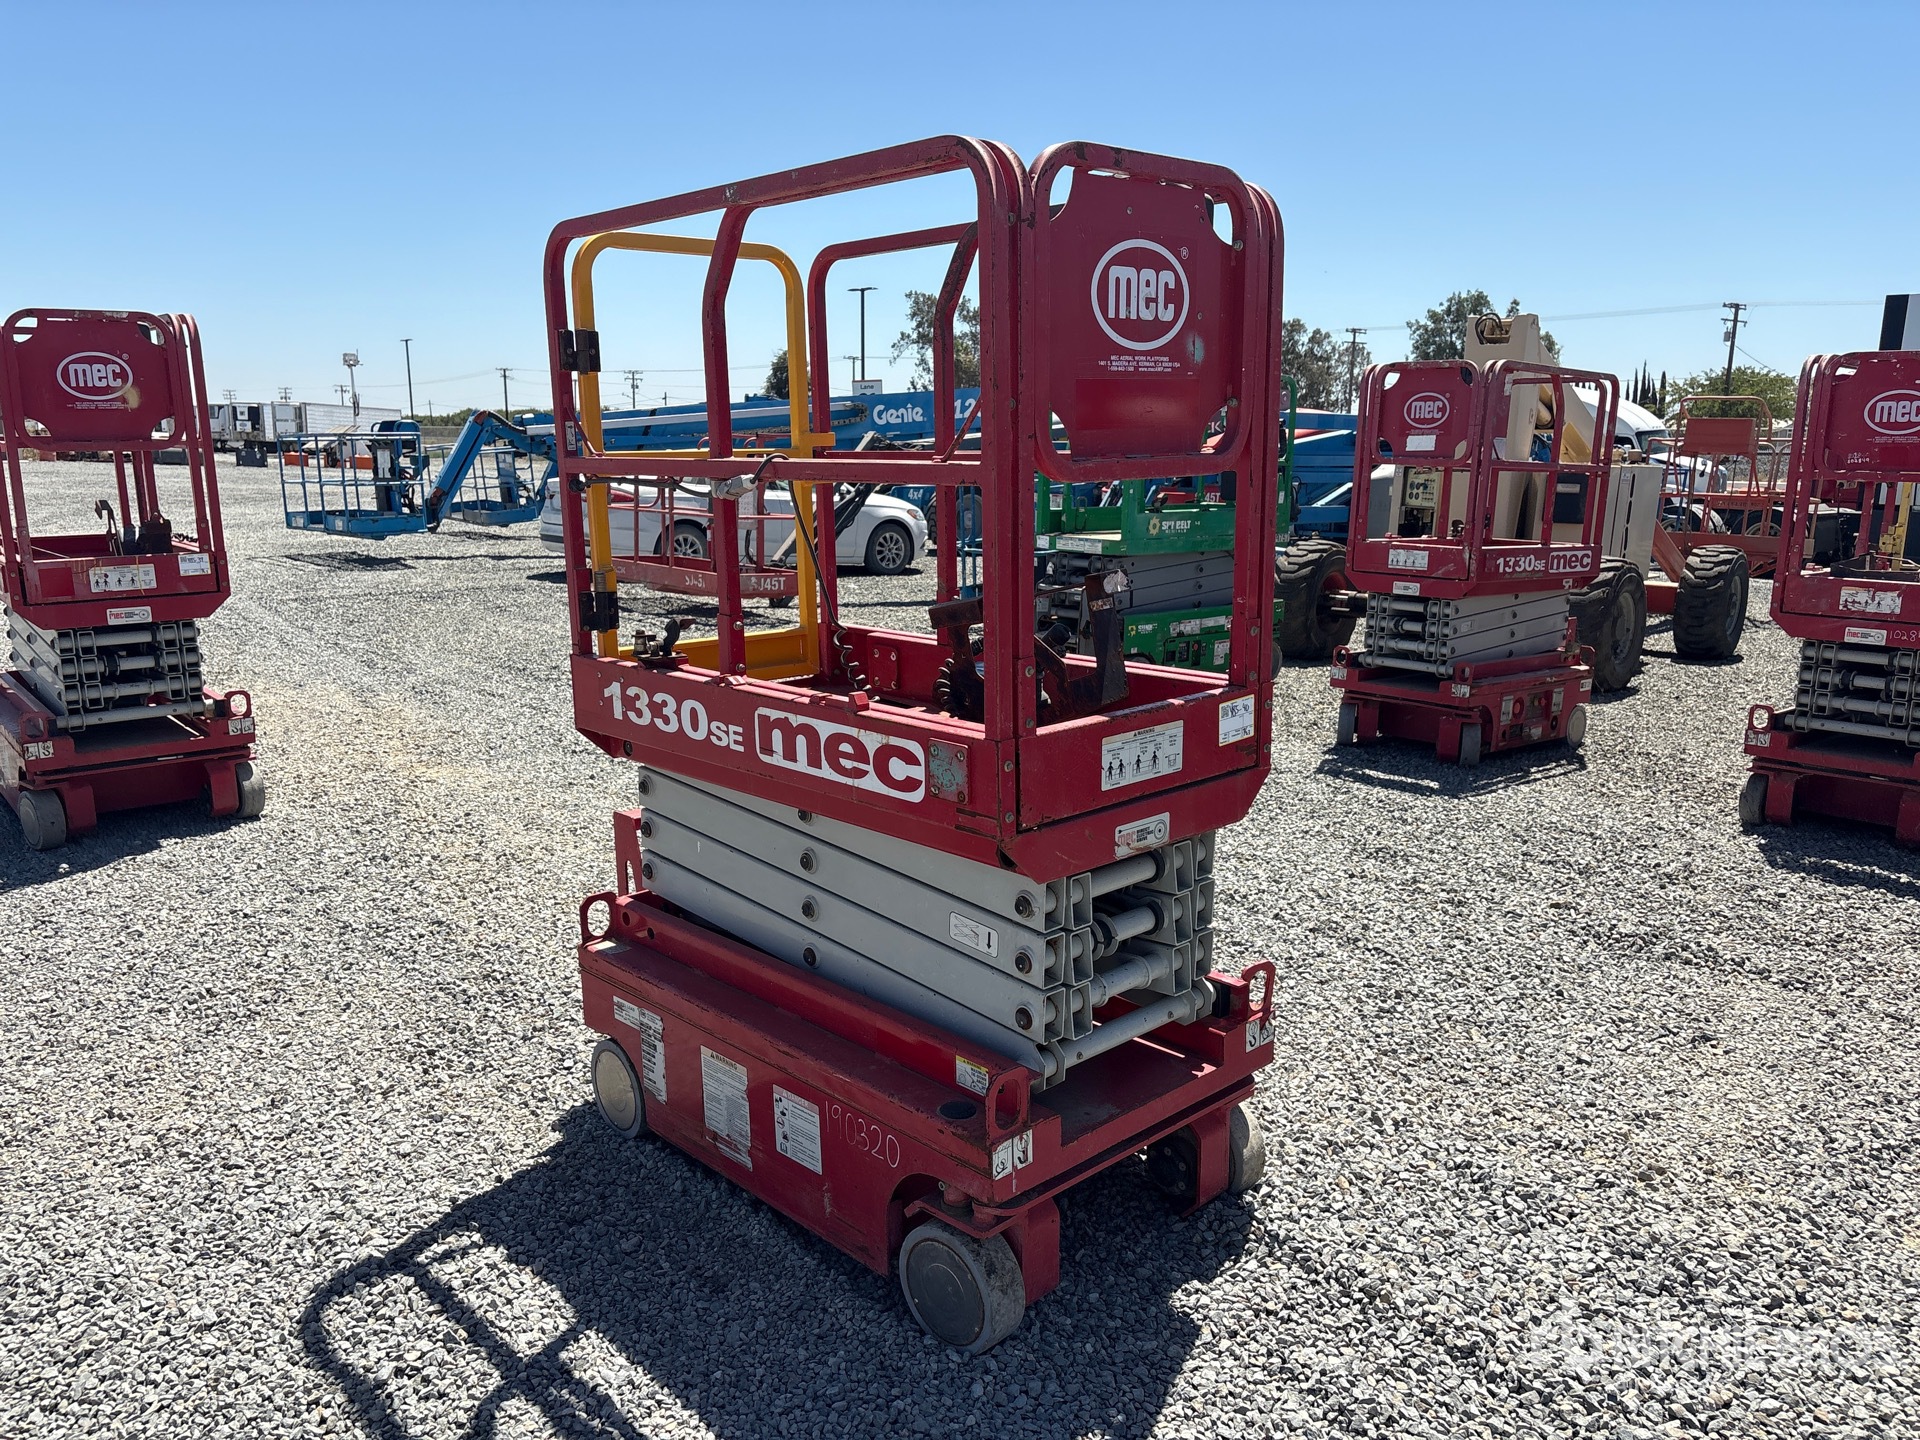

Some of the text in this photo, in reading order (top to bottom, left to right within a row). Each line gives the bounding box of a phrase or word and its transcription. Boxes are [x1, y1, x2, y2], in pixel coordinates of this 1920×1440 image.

[1108, 265, 1175, 321] mec
[68, 364, 122, 387] mec
[1410, 401, 1443, 418] mec
[908, 488, 924, 500] 4x4
[1552, 551, 1591, 570] mec
[1137, 727, 1156, 737] WARNING
[757, 713, 924, 794] mec
[715, 1053, 738, 1071] WARNING
[825, 1100, 900, 1168] 190320
